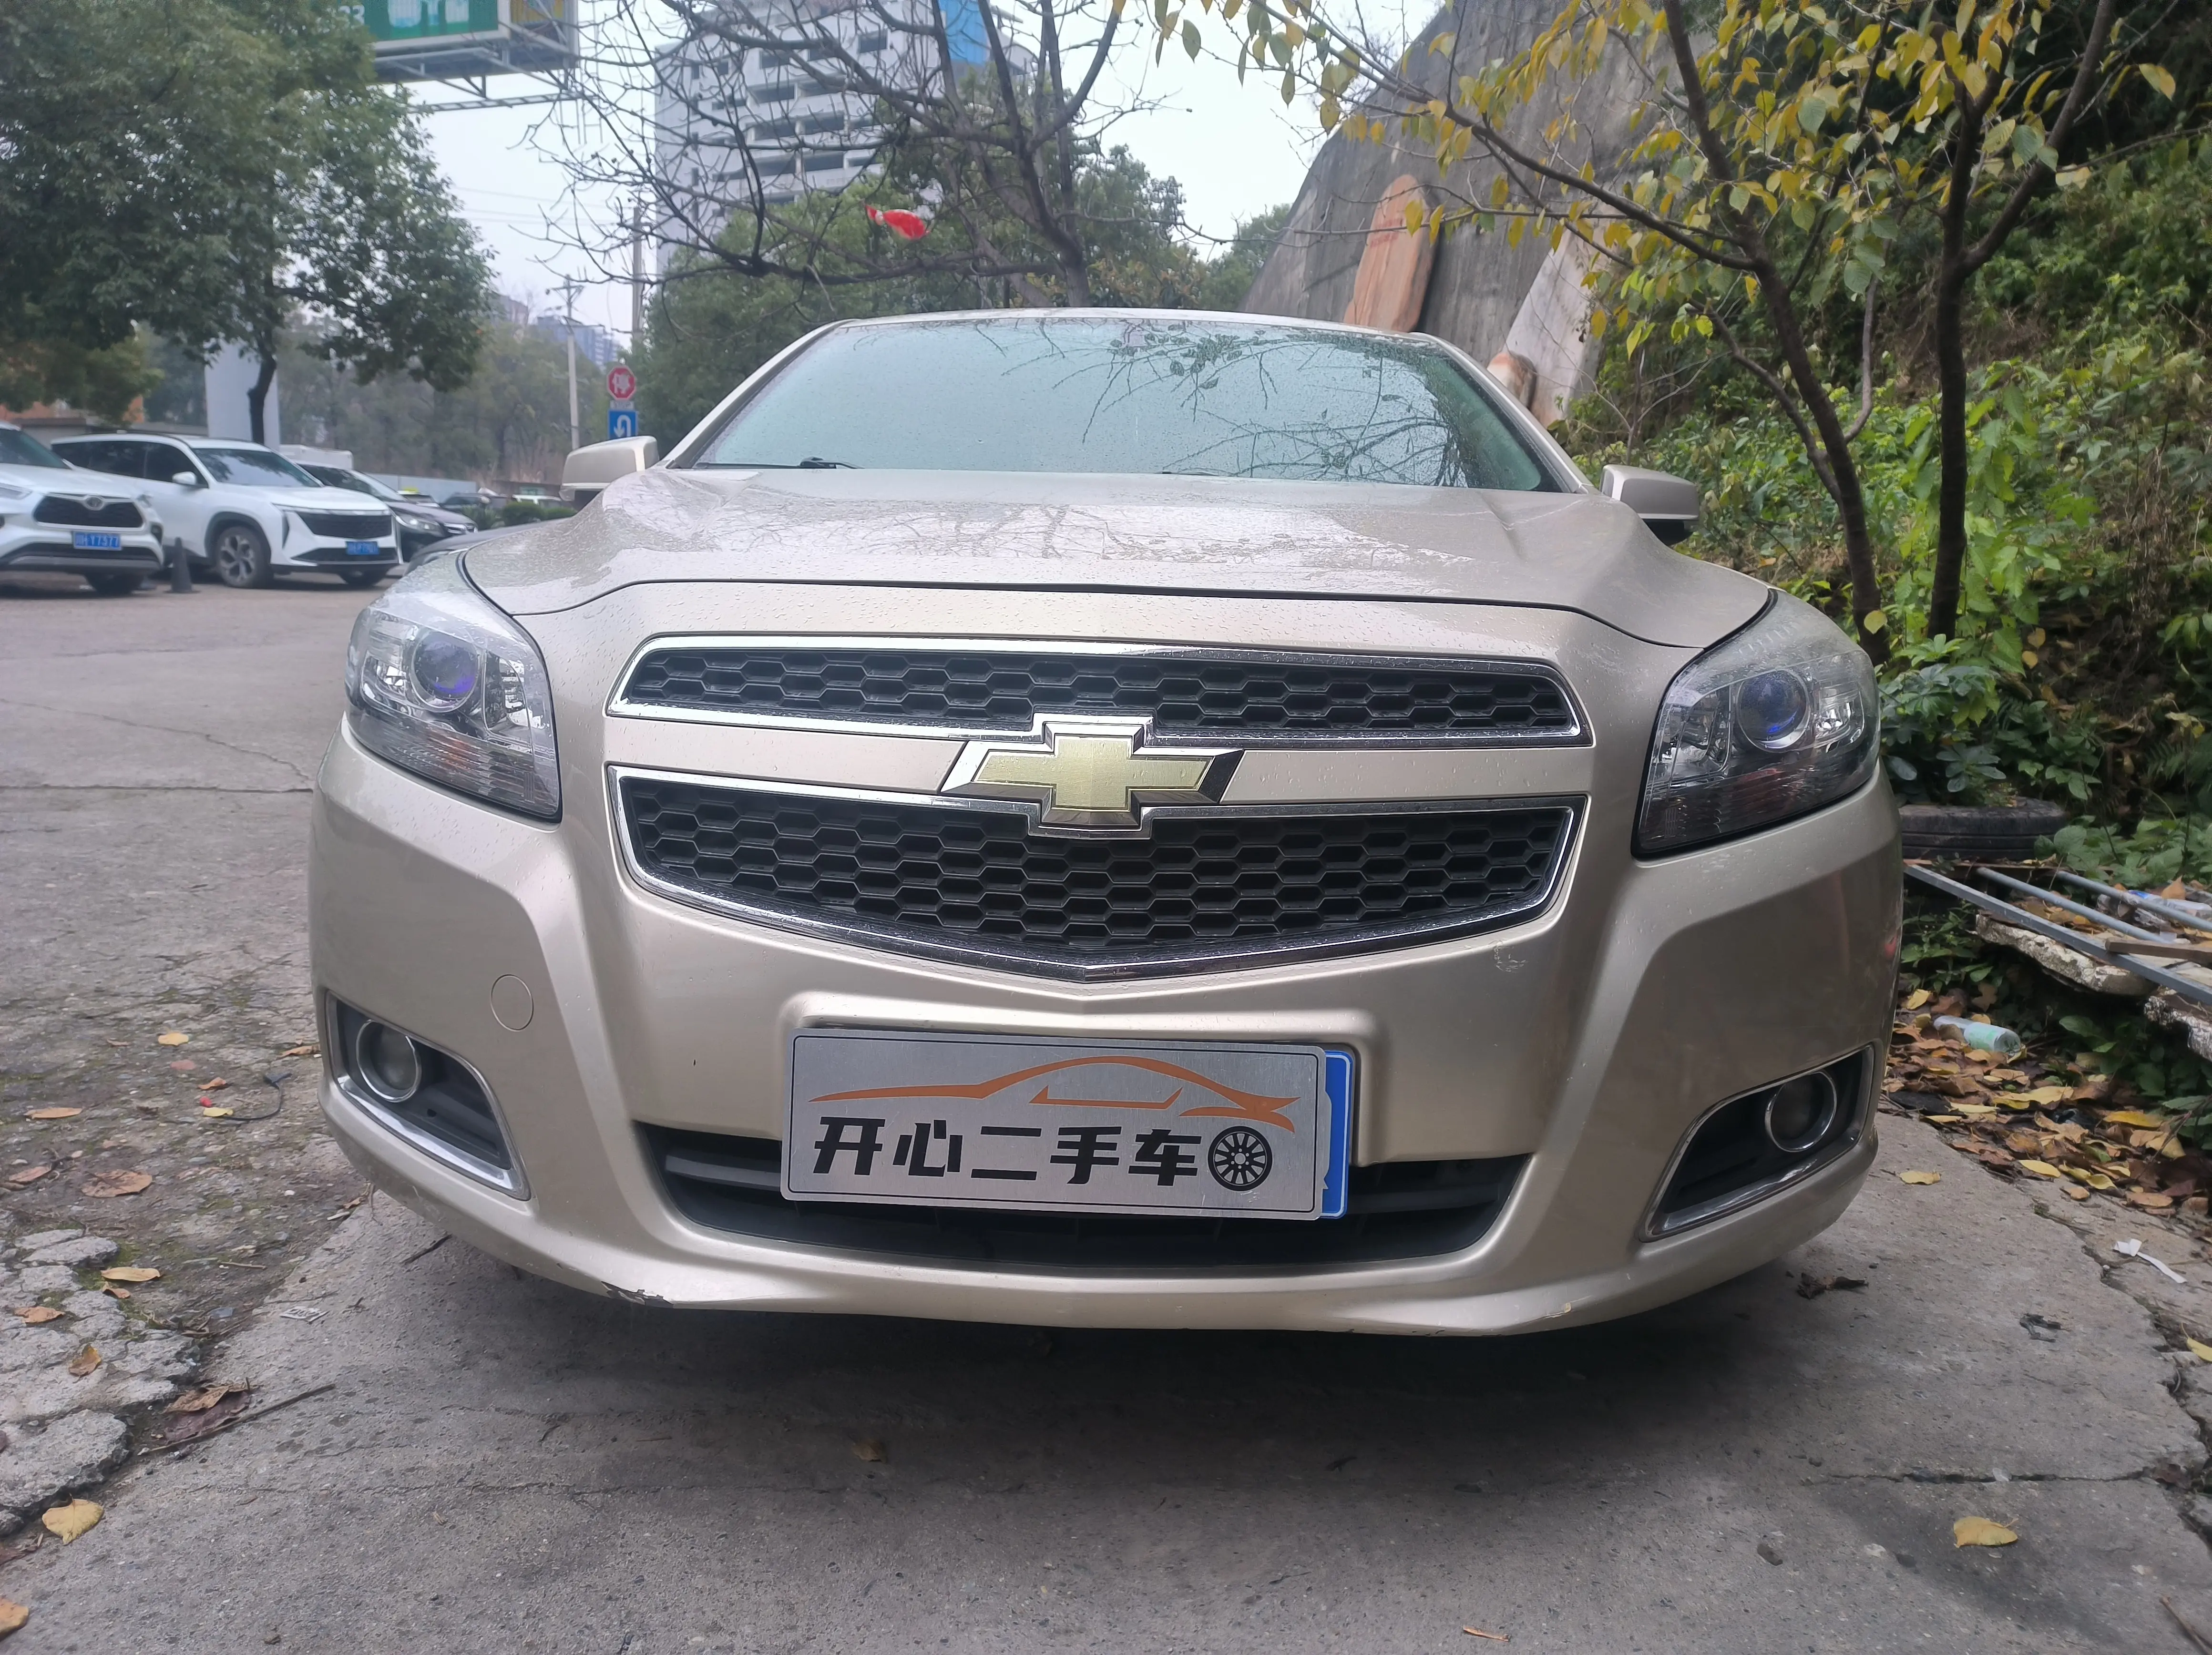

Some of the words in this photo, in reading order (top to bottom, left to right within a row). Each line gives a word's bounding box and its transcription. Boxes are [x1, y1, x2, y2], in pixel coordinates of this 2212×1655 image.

[812, 1116, 1202, 1186] 开心二手车
